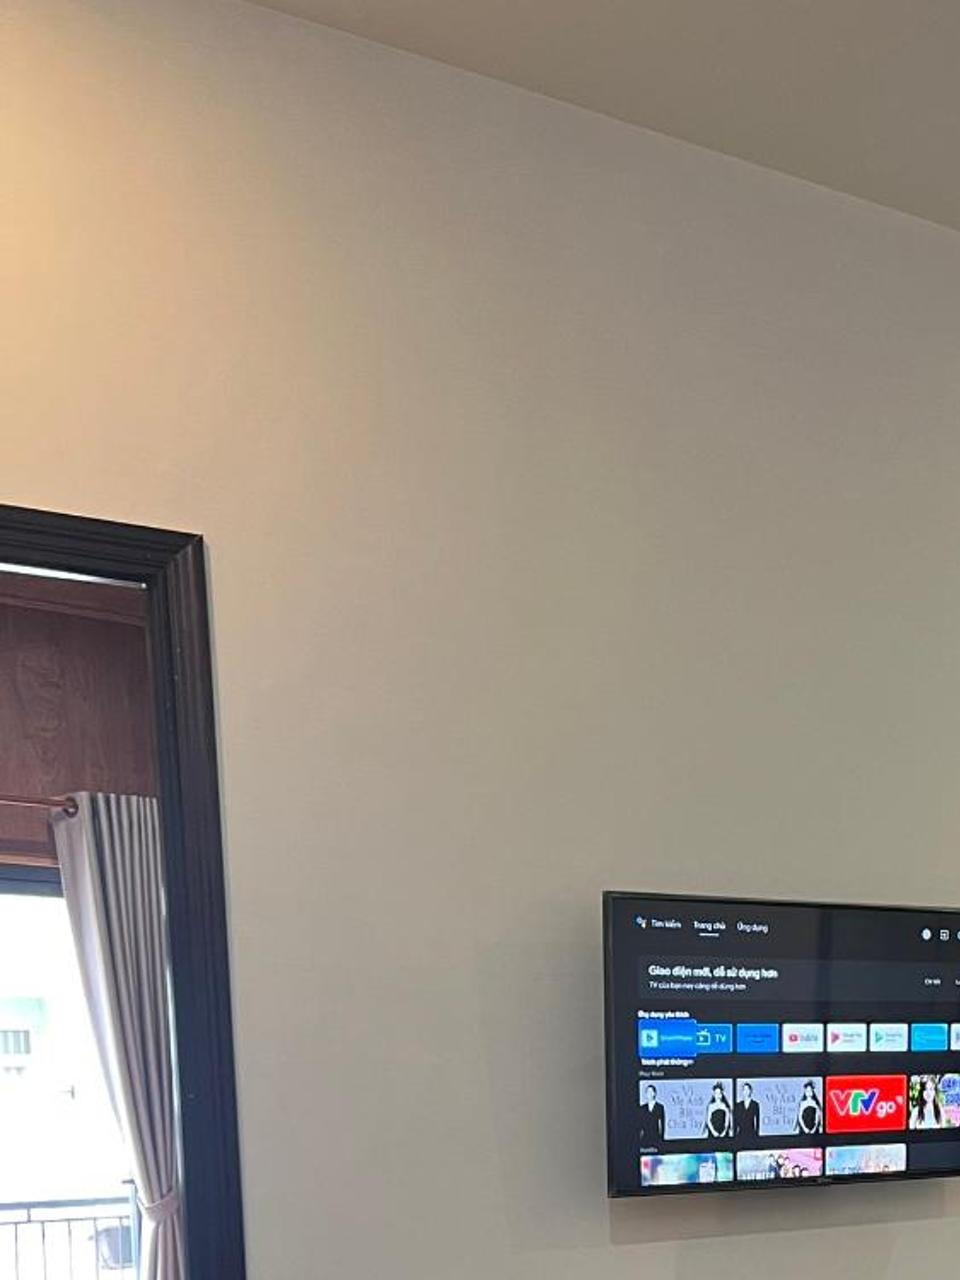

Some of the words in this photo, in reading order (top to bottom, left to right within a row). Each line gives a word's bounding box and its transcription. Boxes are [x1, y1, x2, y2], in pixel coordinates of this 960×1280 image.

[648, 965, 671, 976] Giao
[715, 1034, 727, 1043] TV
[830, 1088, 880, 1116] VTV
[877, 1101, 897, 1118] go
